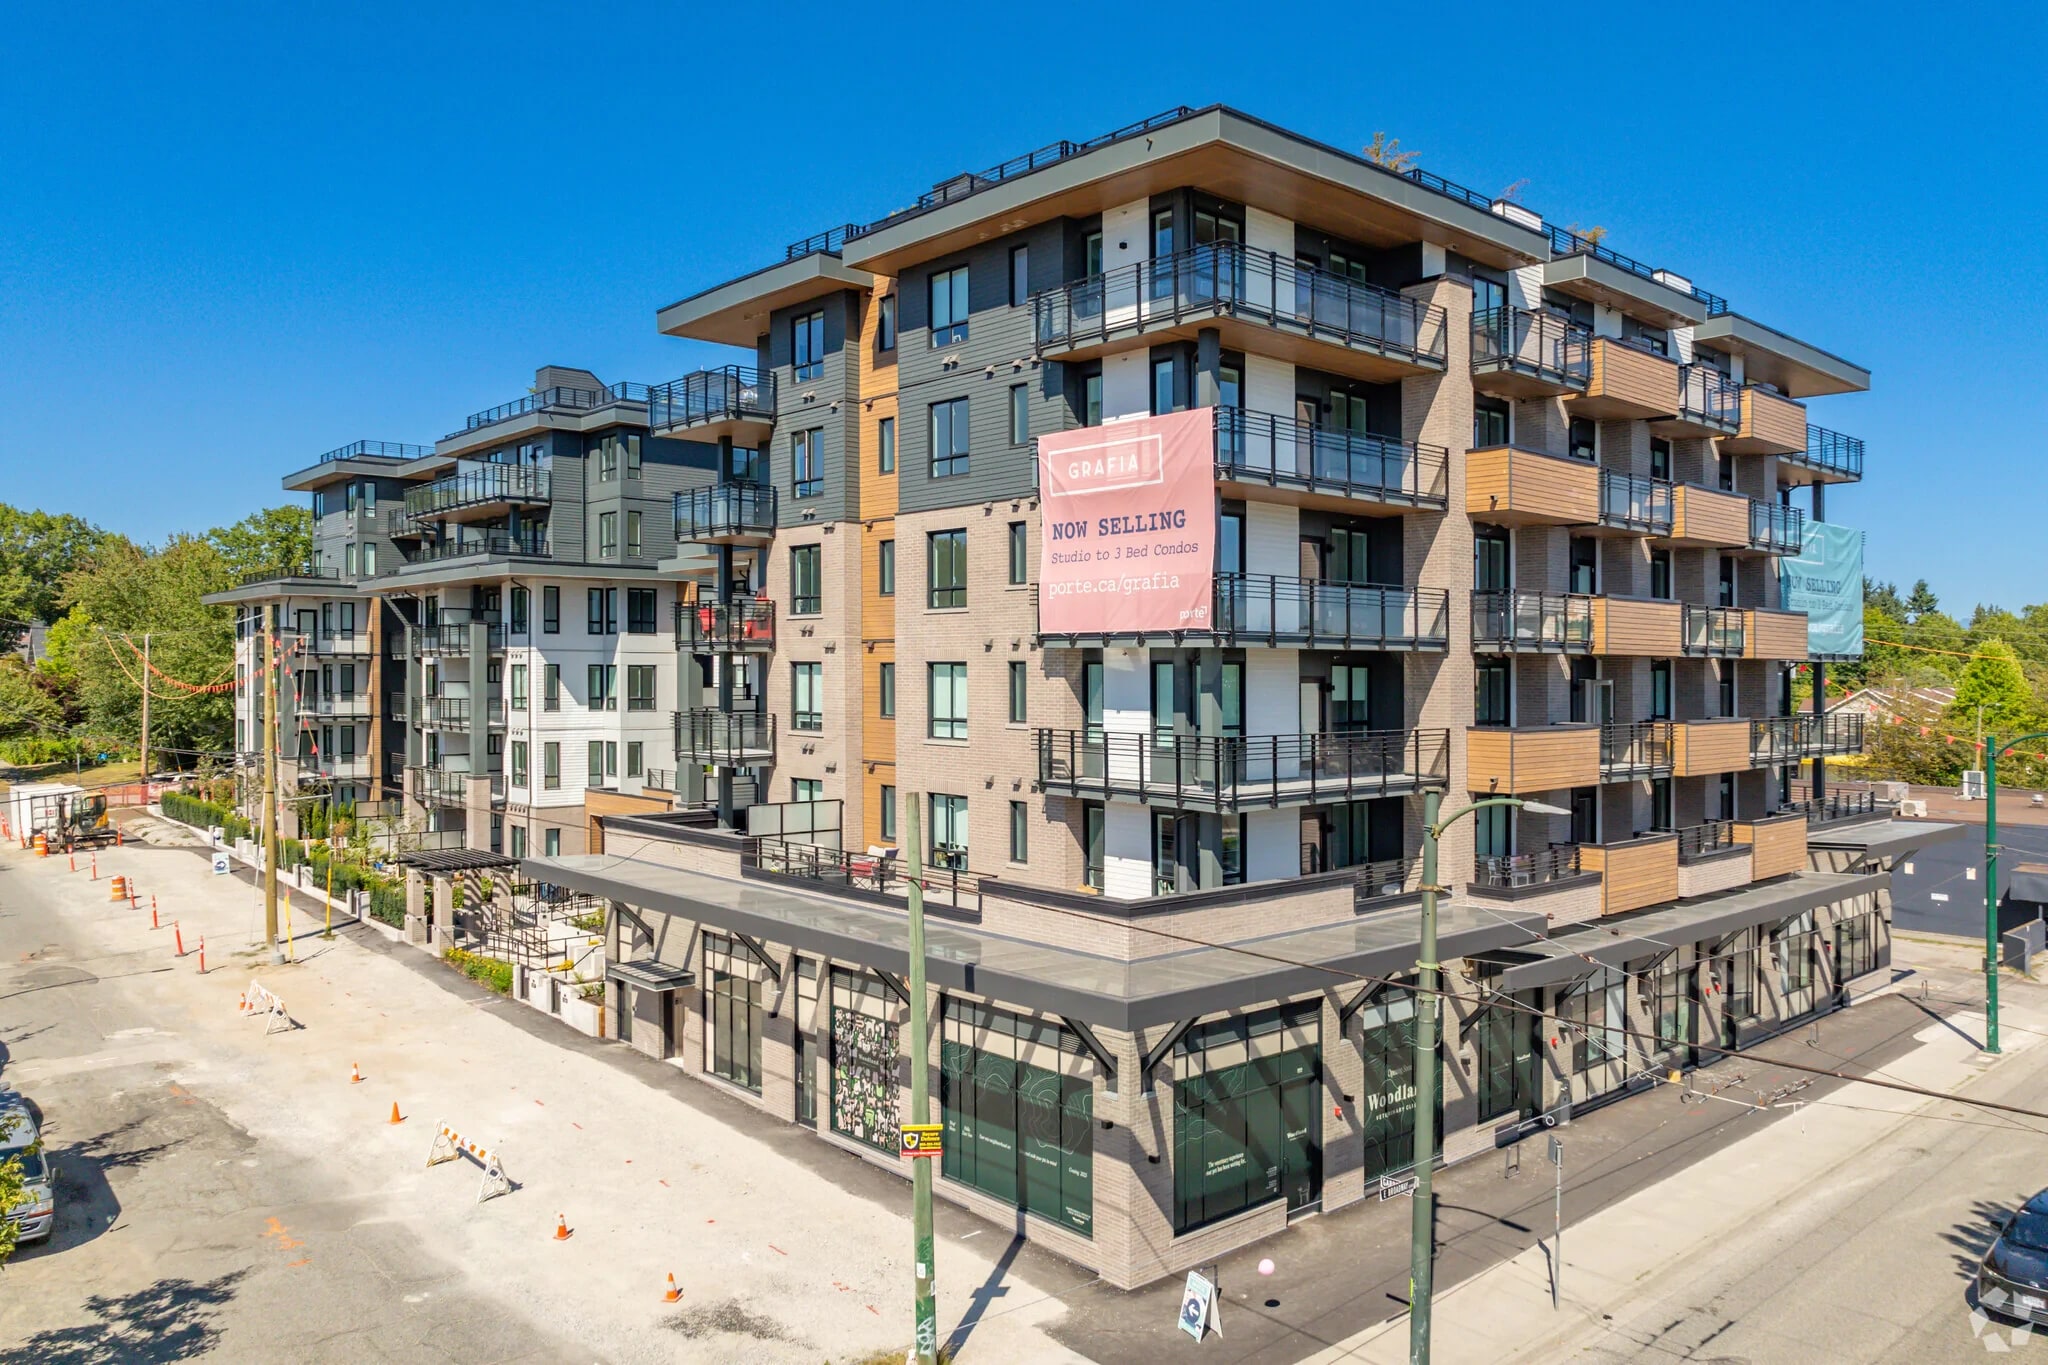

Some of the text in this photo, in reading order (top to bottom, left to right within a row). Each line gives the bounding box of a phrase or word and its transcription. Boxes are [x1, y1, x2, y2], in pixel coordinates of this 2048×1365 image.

[1068, 454, 1138, 479] GRAFIA
[1052, 509, 1186, 540] NOW SELLING
[1051, 541, 1199, 564] Studio to 3 Bed Condos
[1048, 571, 1180, 600] porte.ca/grafia
[1805, 577, 1841, 594] SELLING
[1179, 607, 1206, 621] porte
[1367, 1084, 1417, 1112] Woodla
